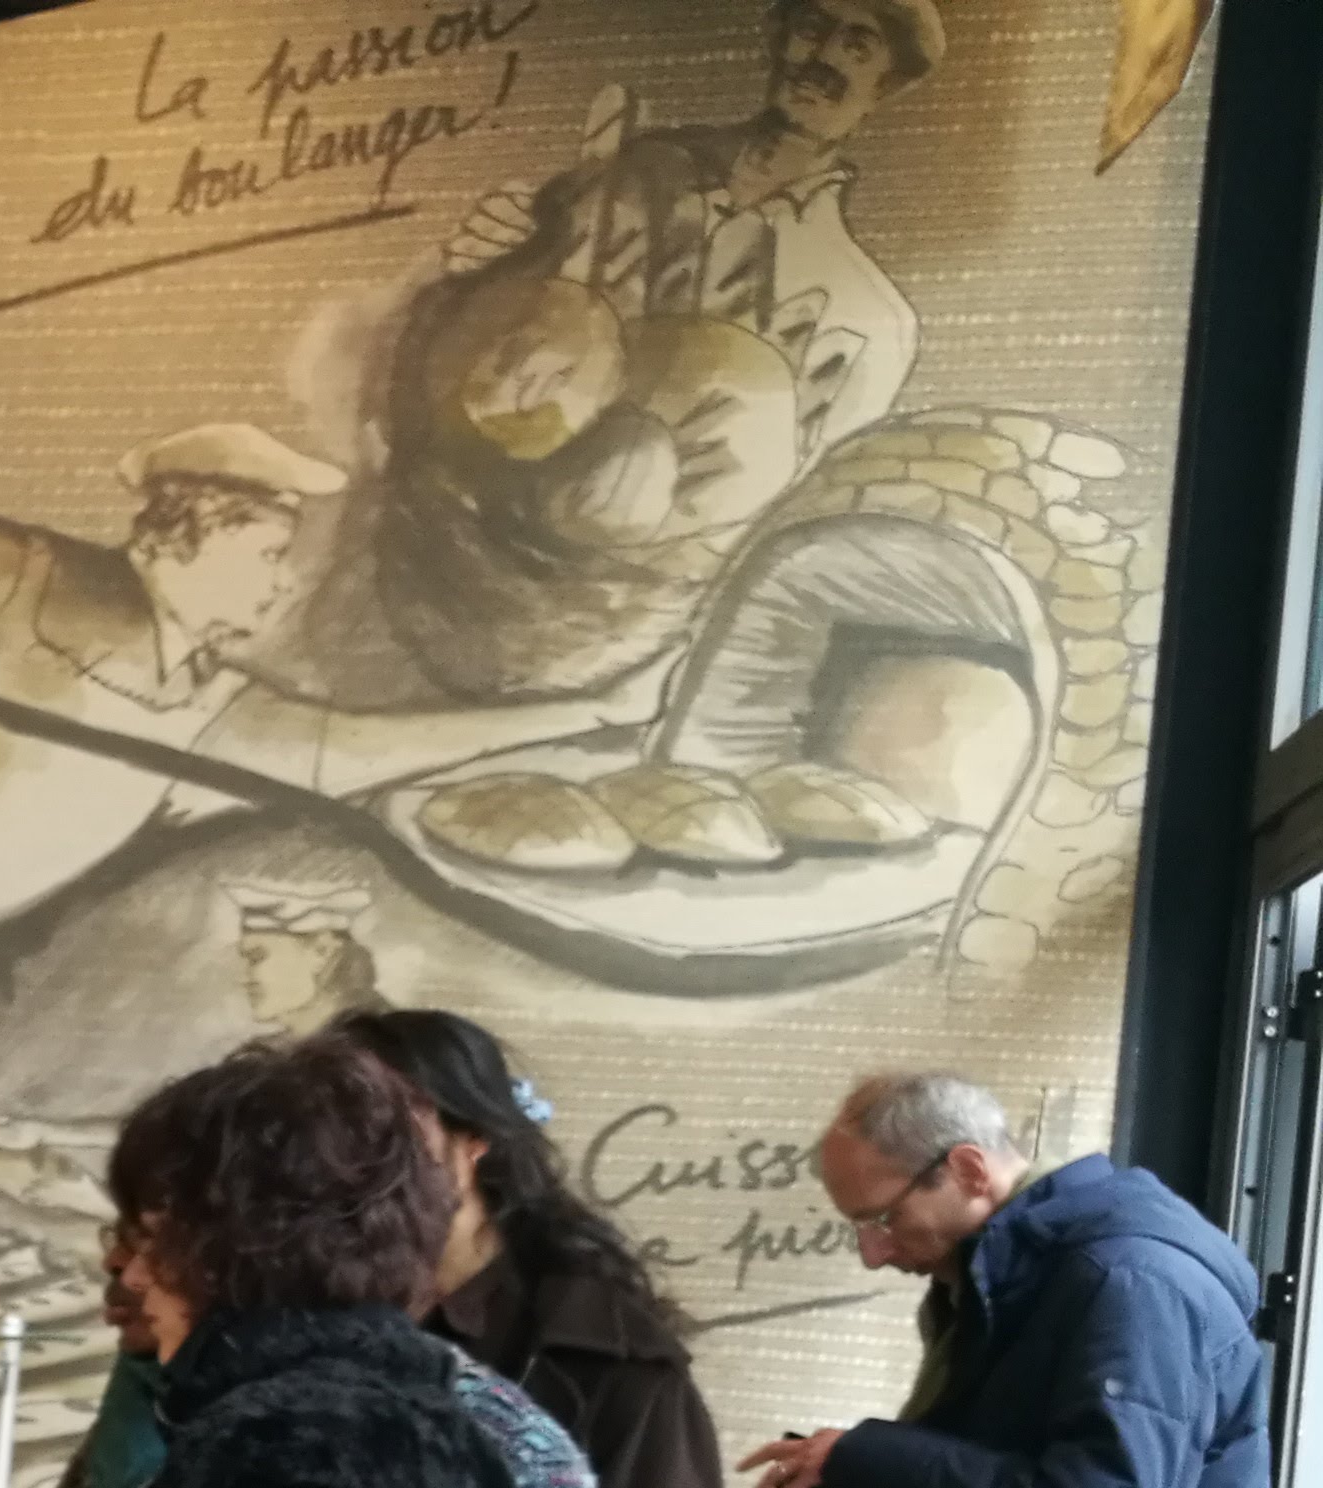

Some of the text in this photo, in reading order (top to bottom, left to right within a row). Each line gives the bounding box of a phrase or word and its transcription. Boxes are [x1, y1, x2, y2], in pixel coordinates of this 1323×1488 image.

[136, 0, 540, 138] La passion
[30, 157, 135, 244] du
[581, 1104, 823, 1209] Cuiss
